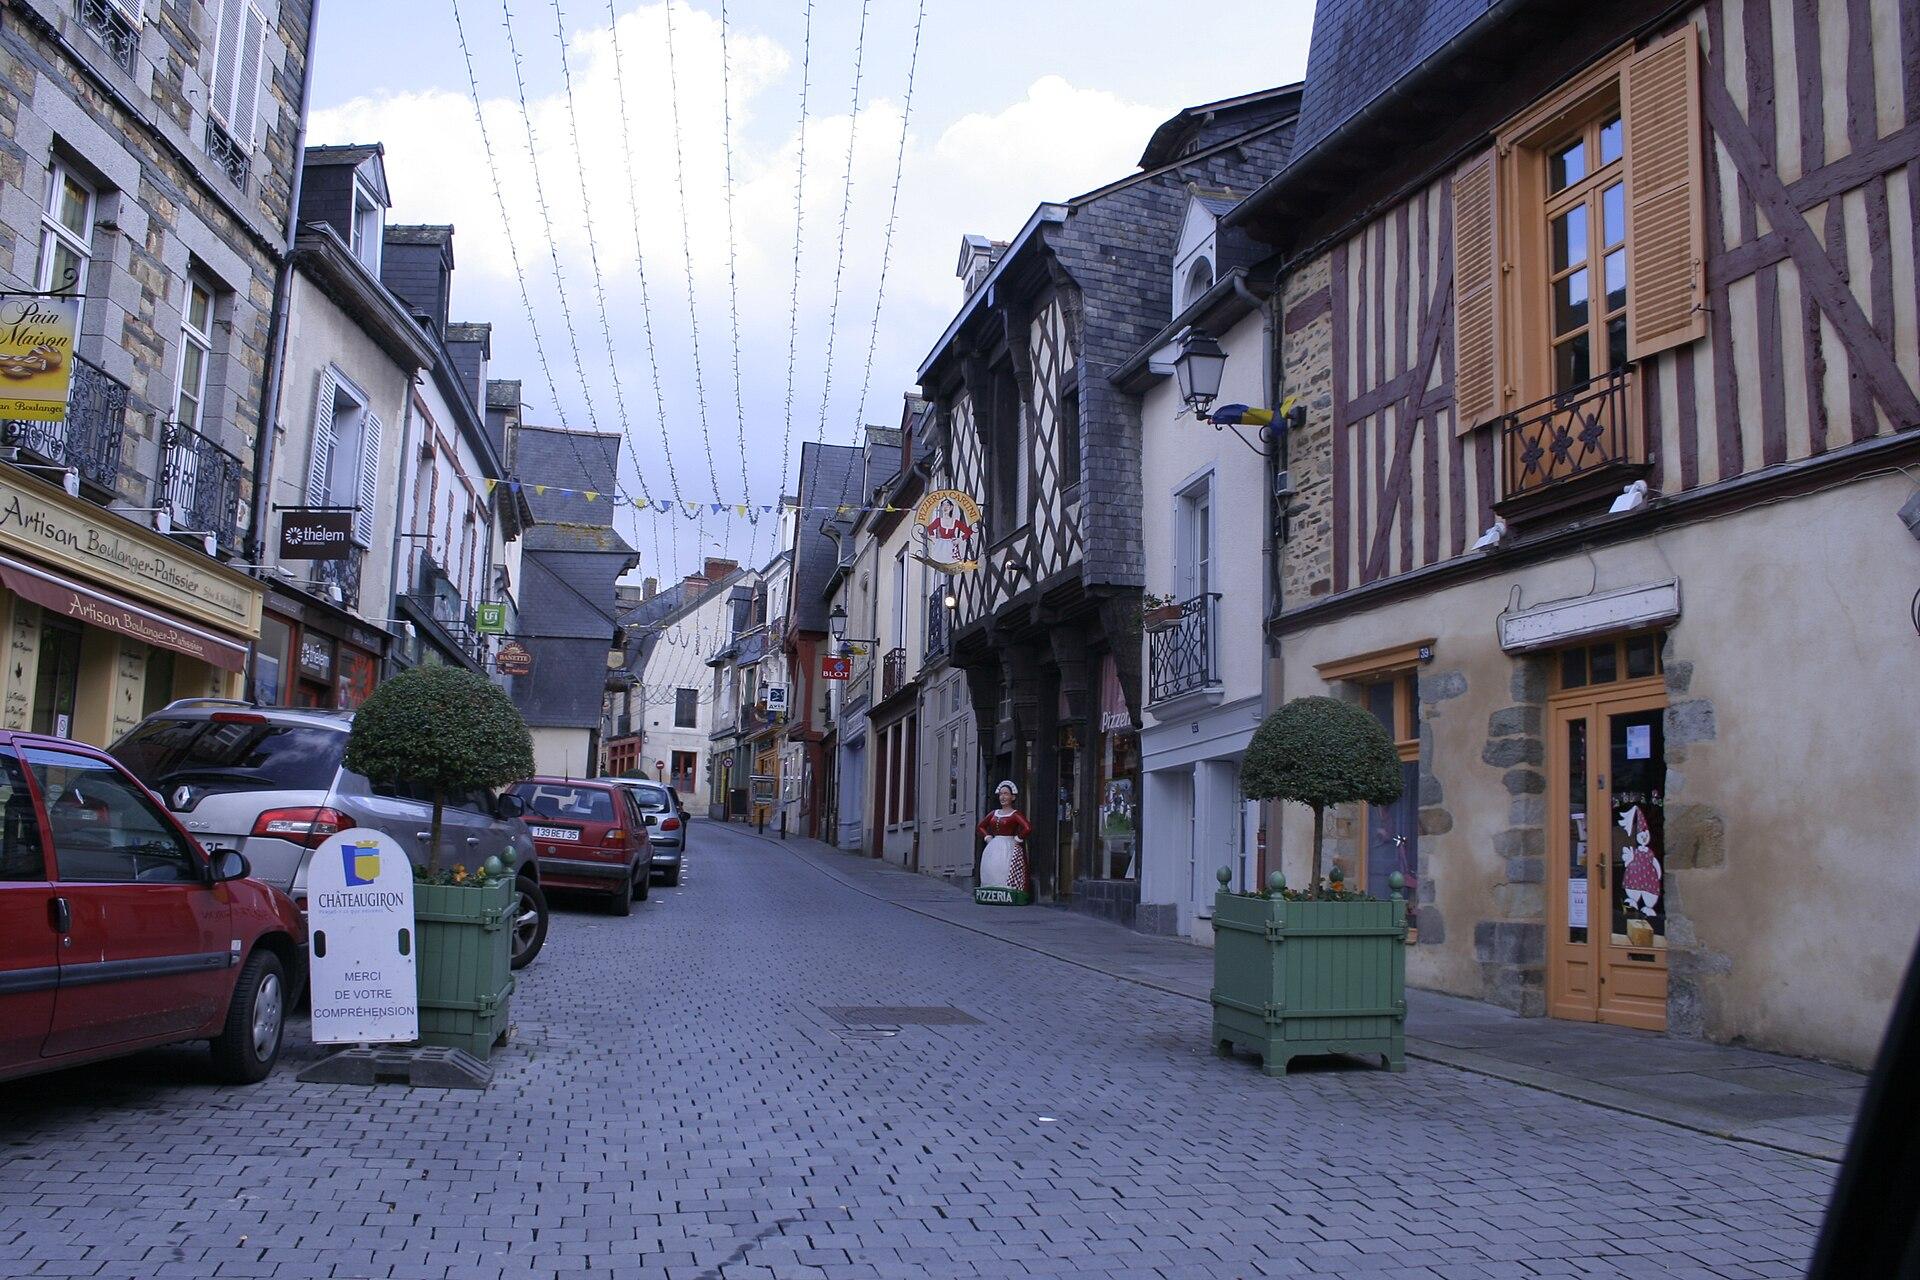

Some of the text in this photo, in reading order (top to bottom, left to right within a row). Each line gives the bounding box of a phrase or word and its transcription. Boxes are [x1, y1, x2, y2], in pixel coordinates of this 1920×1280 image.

[1, 300, 60, 325] Pain
[0, 323, 68, 347] Maison
[918, 492, 947, 521] PIZZERIA
[0, 496, 80, 550] Artisan
[304, 525, 344, 541] thélem
[69, 594, 120, 628] Artisan
[822, 670, 849, 678] BLOT
[536, 828, 550, 837] 139
[566, 831, 577, 839] 35
[318, 890, 403, 912] CHÂTEAUGIRON
[976, 889, 1012, 903] PIZZERIA
[344, 971, 381, 981] MERCI
[334, 989, 392, 1000] DE VOTRE
[313, 1006, 415, 1018] COMPRÉHENSION
